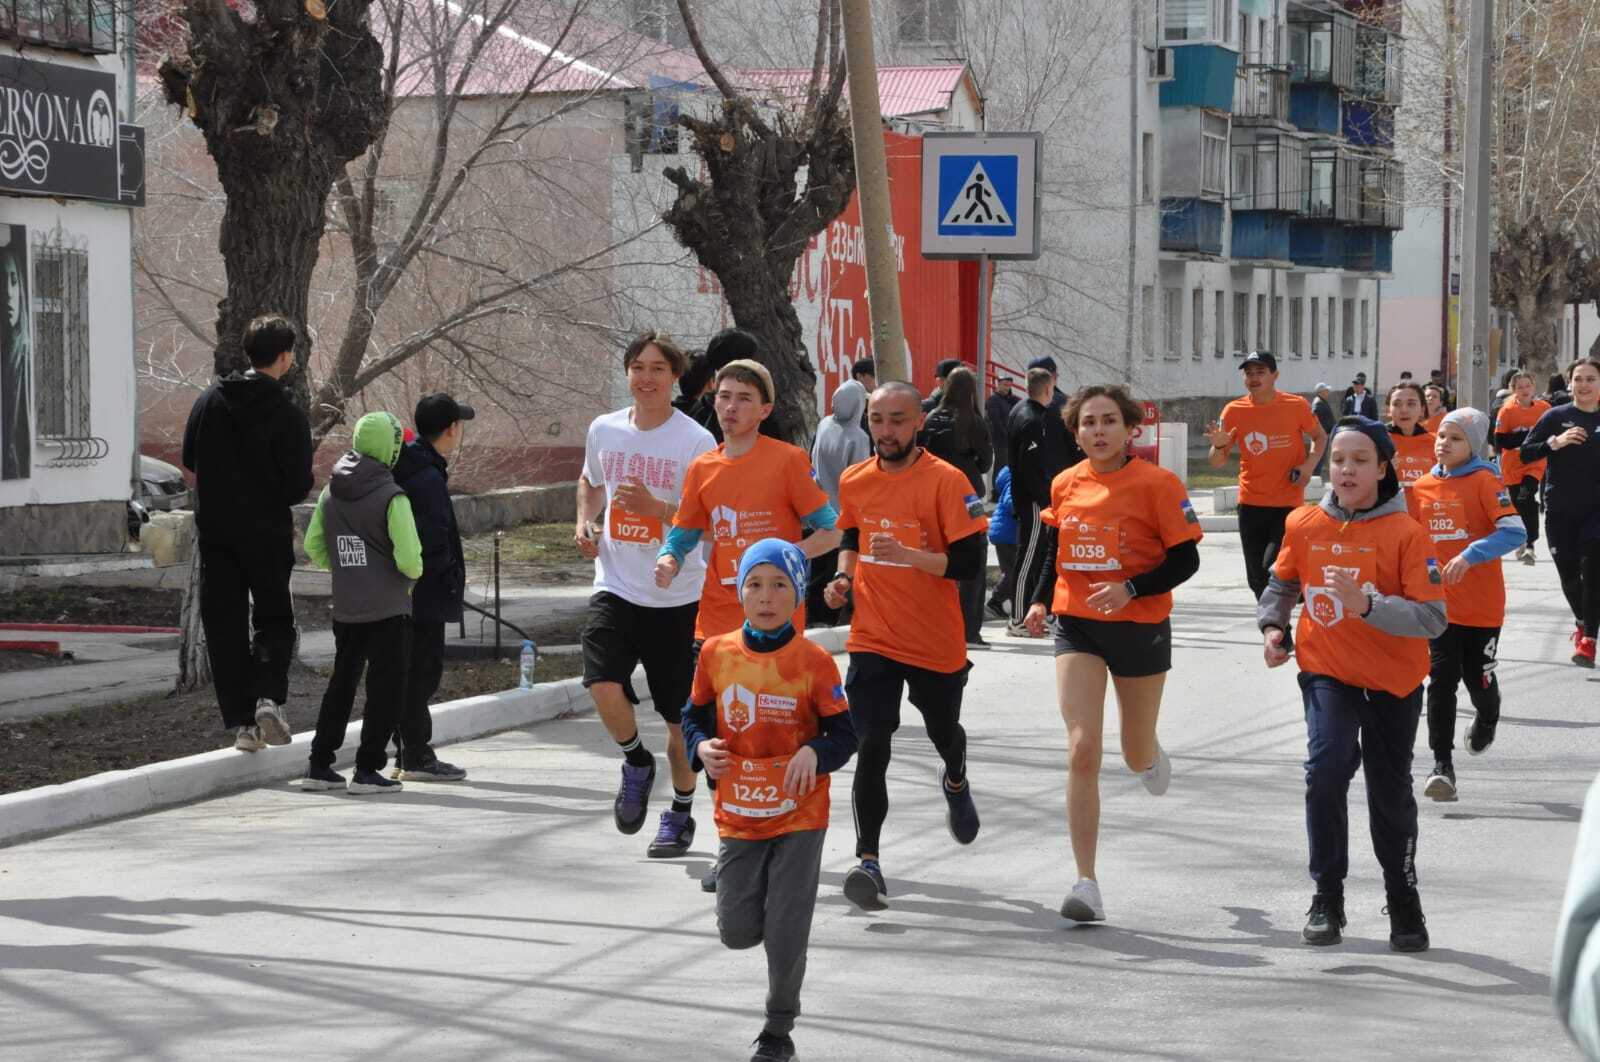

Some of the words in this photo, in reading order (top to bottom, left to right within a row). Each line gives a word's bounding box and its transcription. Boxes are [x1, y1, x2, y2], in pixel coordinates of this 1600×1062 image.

[617, 523, 649, 538] 1072
[1428, 519, 1455, 531] 1282
[339, 537, 354, 552] ON
[1070, 544, 1106, 559] 1038
[340, 553, 365, 565] WAVE
[733, 783, 778, 802] 1242
